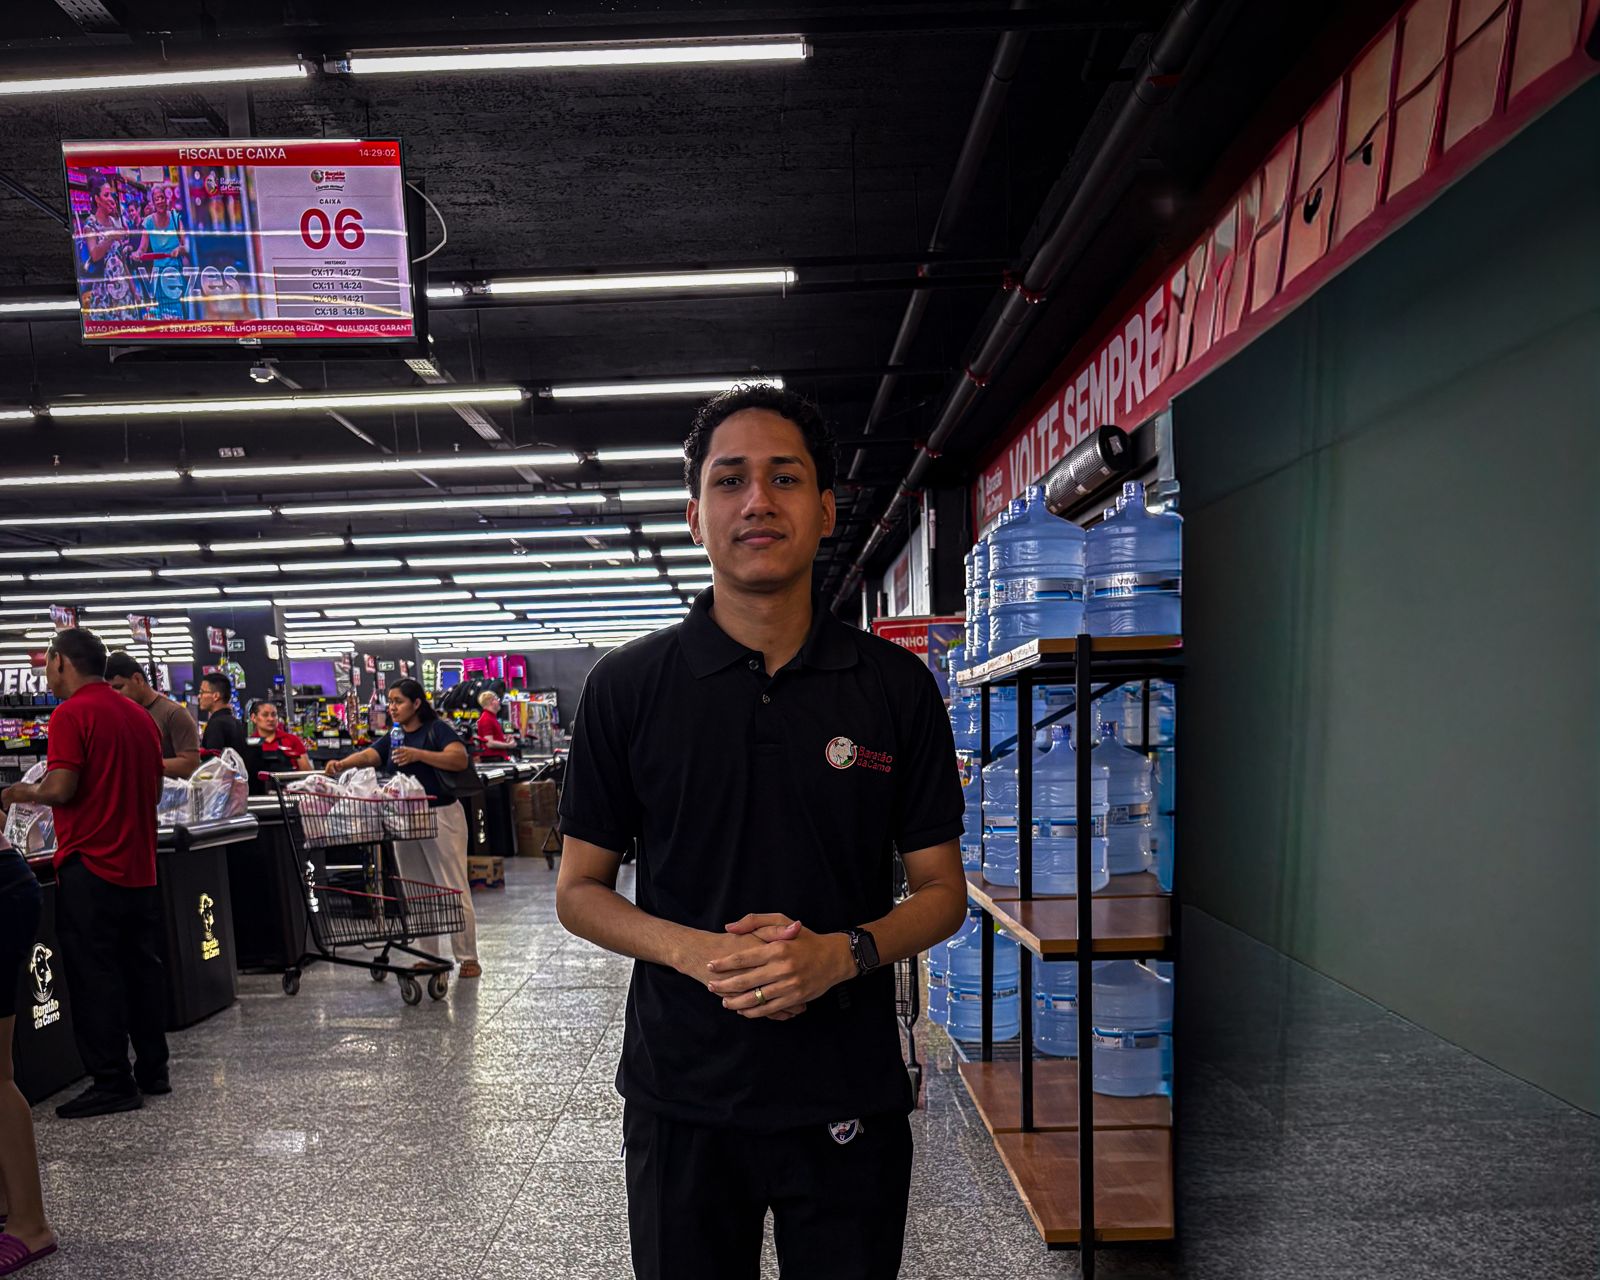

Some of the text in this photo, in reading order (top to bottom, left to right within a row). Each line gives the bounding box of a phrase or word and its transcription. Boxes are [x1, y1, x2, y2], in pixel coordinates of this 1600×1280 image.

[179, 147, 287, 160] FISCAL DE CAIXA
[358, 148, 396, 157] 14:29:02
[300, 208, 365, 250] 06
[311, 268, 361, 277] CX:17 14:27
[137, 265, 240, 300] vezes
[312, 282, 362, 290] CX:11 14:24
[342, 294, 364, 302] 14:21
[314, 308, 365, 316] CX:18 14:18
[186, 325, 213, 333] JUROS
[336, 323, 379, 332] QUALIDADE
[1009, 284, 1164, 499] VOLTE SEMPRE
